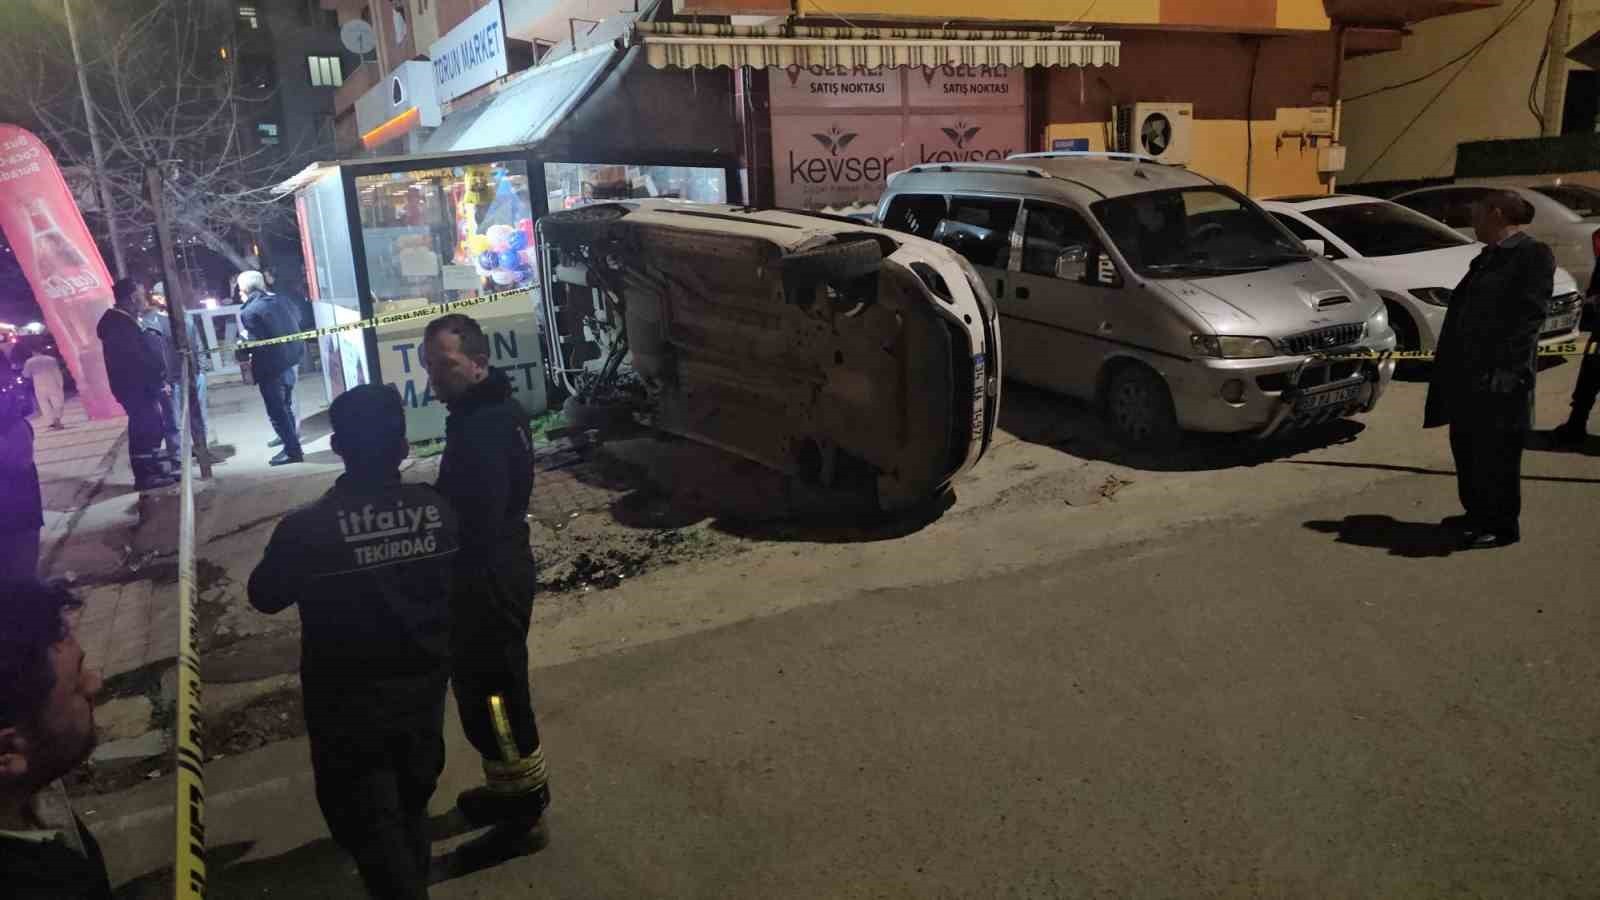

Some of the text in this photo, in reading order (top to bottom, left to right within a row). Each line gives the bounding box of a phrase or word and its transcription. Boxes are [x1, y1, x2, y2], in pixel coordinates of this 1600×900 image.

[433, 21, 498, 85] TORUN MARKET
[810, 82, 885, 95] SATIŞ NOKTASI
[943, 83, 1009, 95] SATIŞ NOKTASI
[788, 150, 894, 184] kevser
[337, 500, 441, 536] itfaiye
[353, 530, 437, 566] TEKİRDAĞ
